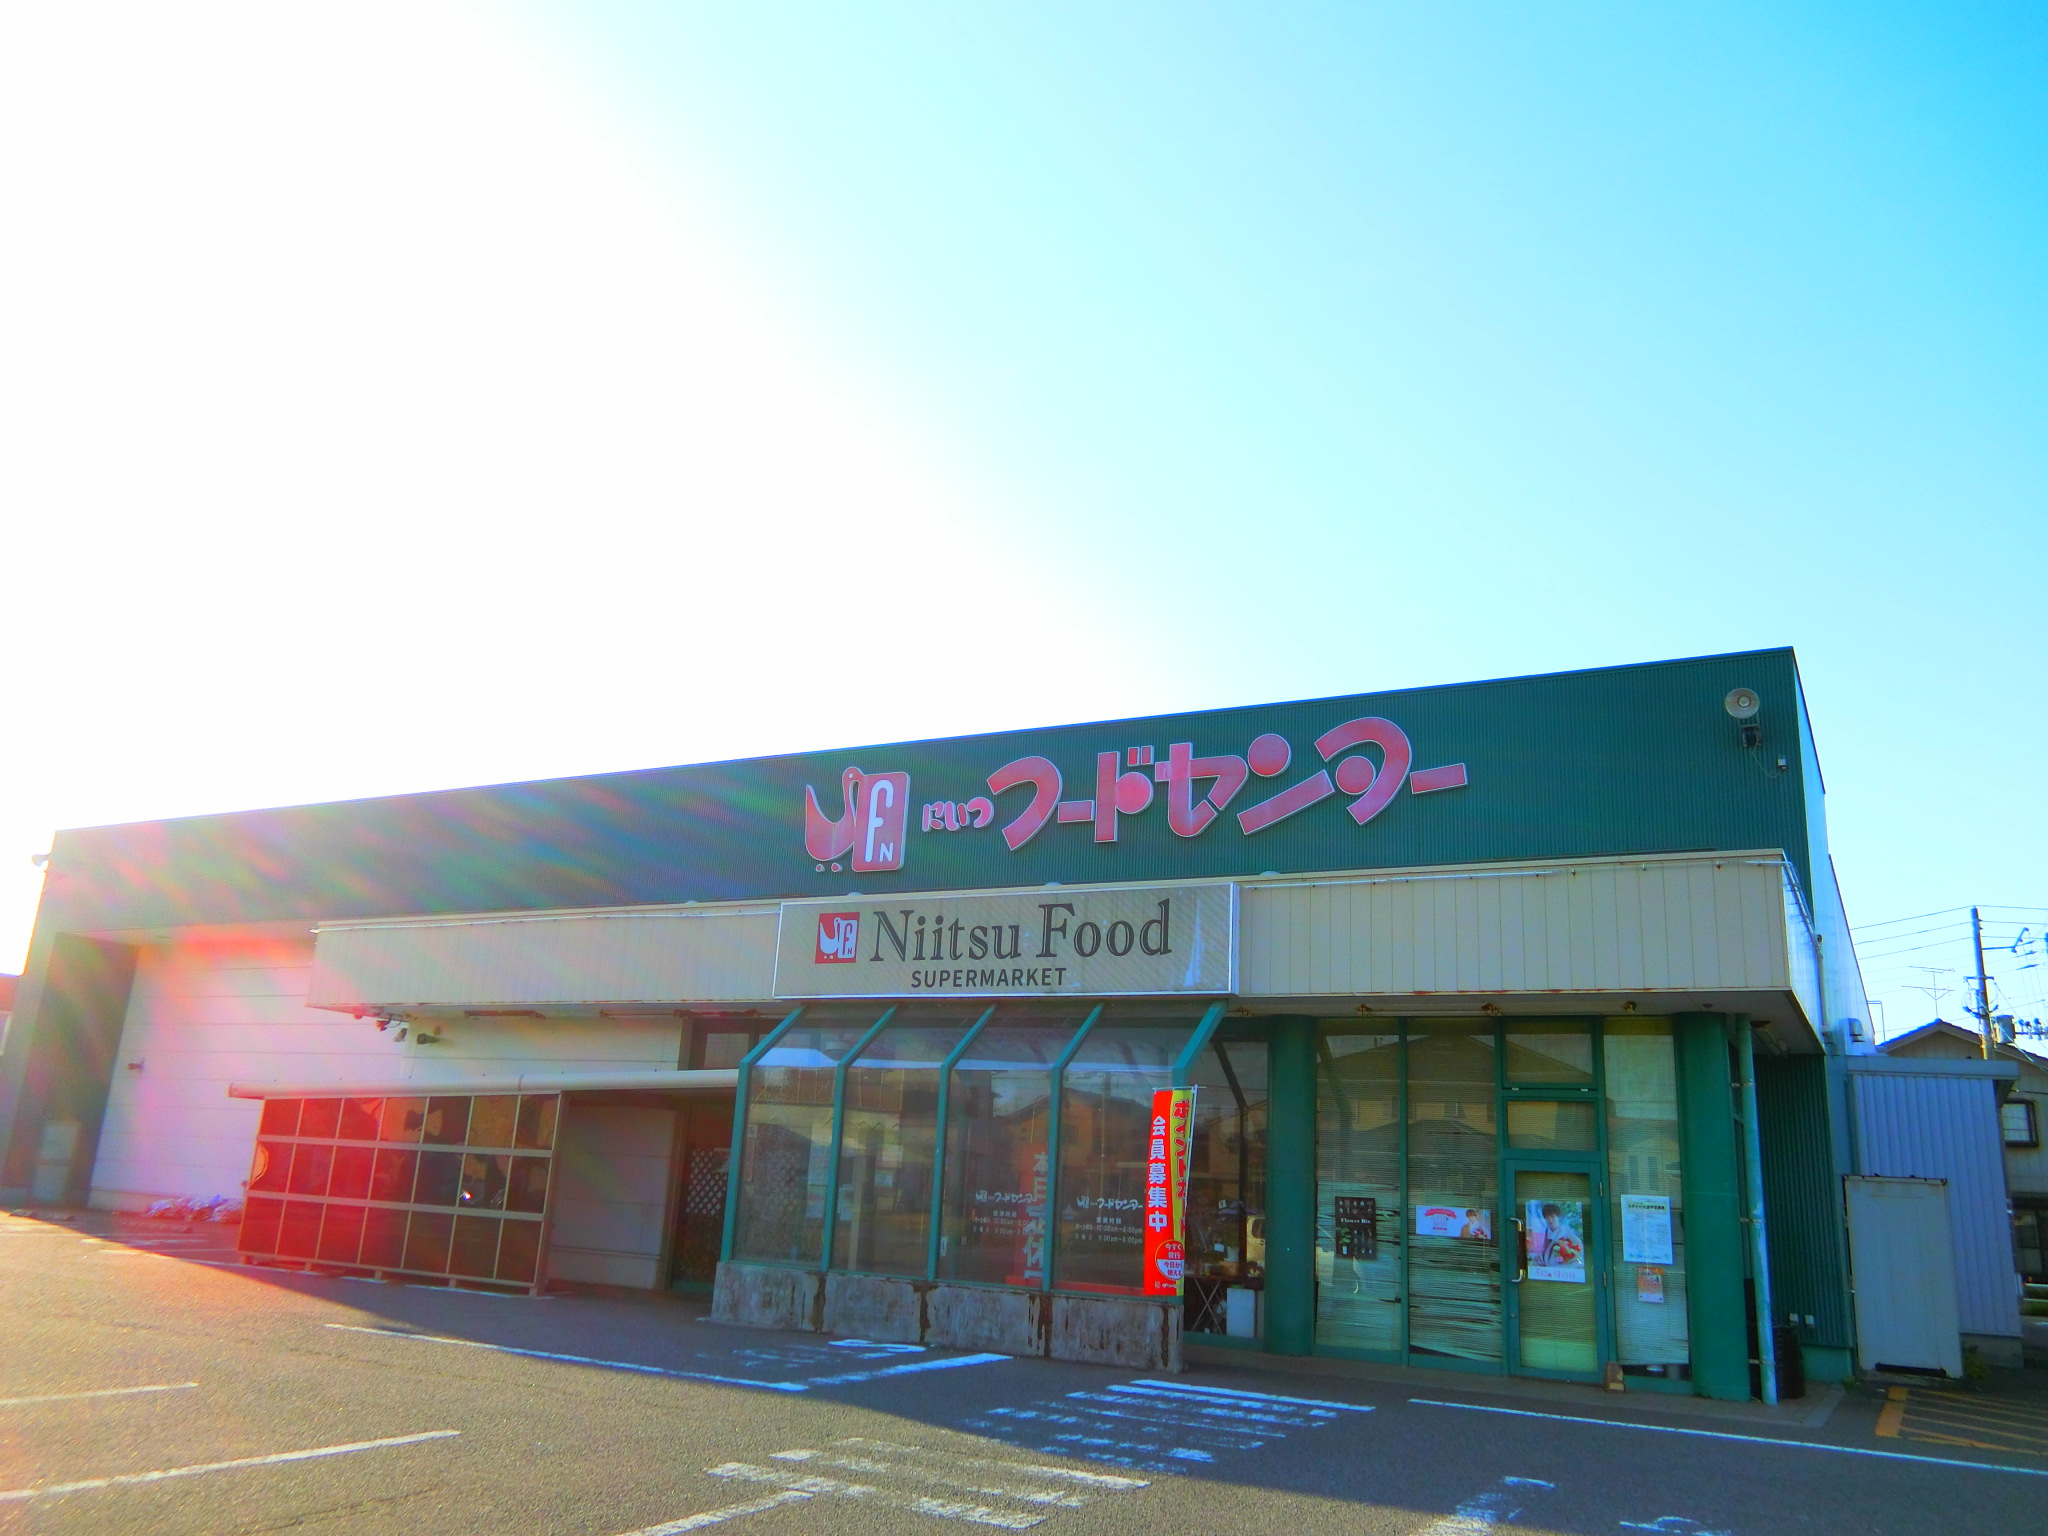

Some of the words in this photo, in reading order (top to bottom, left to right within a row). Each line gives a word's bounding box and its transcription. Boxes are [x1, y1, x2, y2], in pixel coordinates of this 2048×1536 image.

[869, 908, 1022, 963] Niitsu
[1036, 899, 1173, 959] Food
[911, 966, 1068, 990] SUPERMARKET
[1148, 1116, 1167, 1232] 会員募集中
